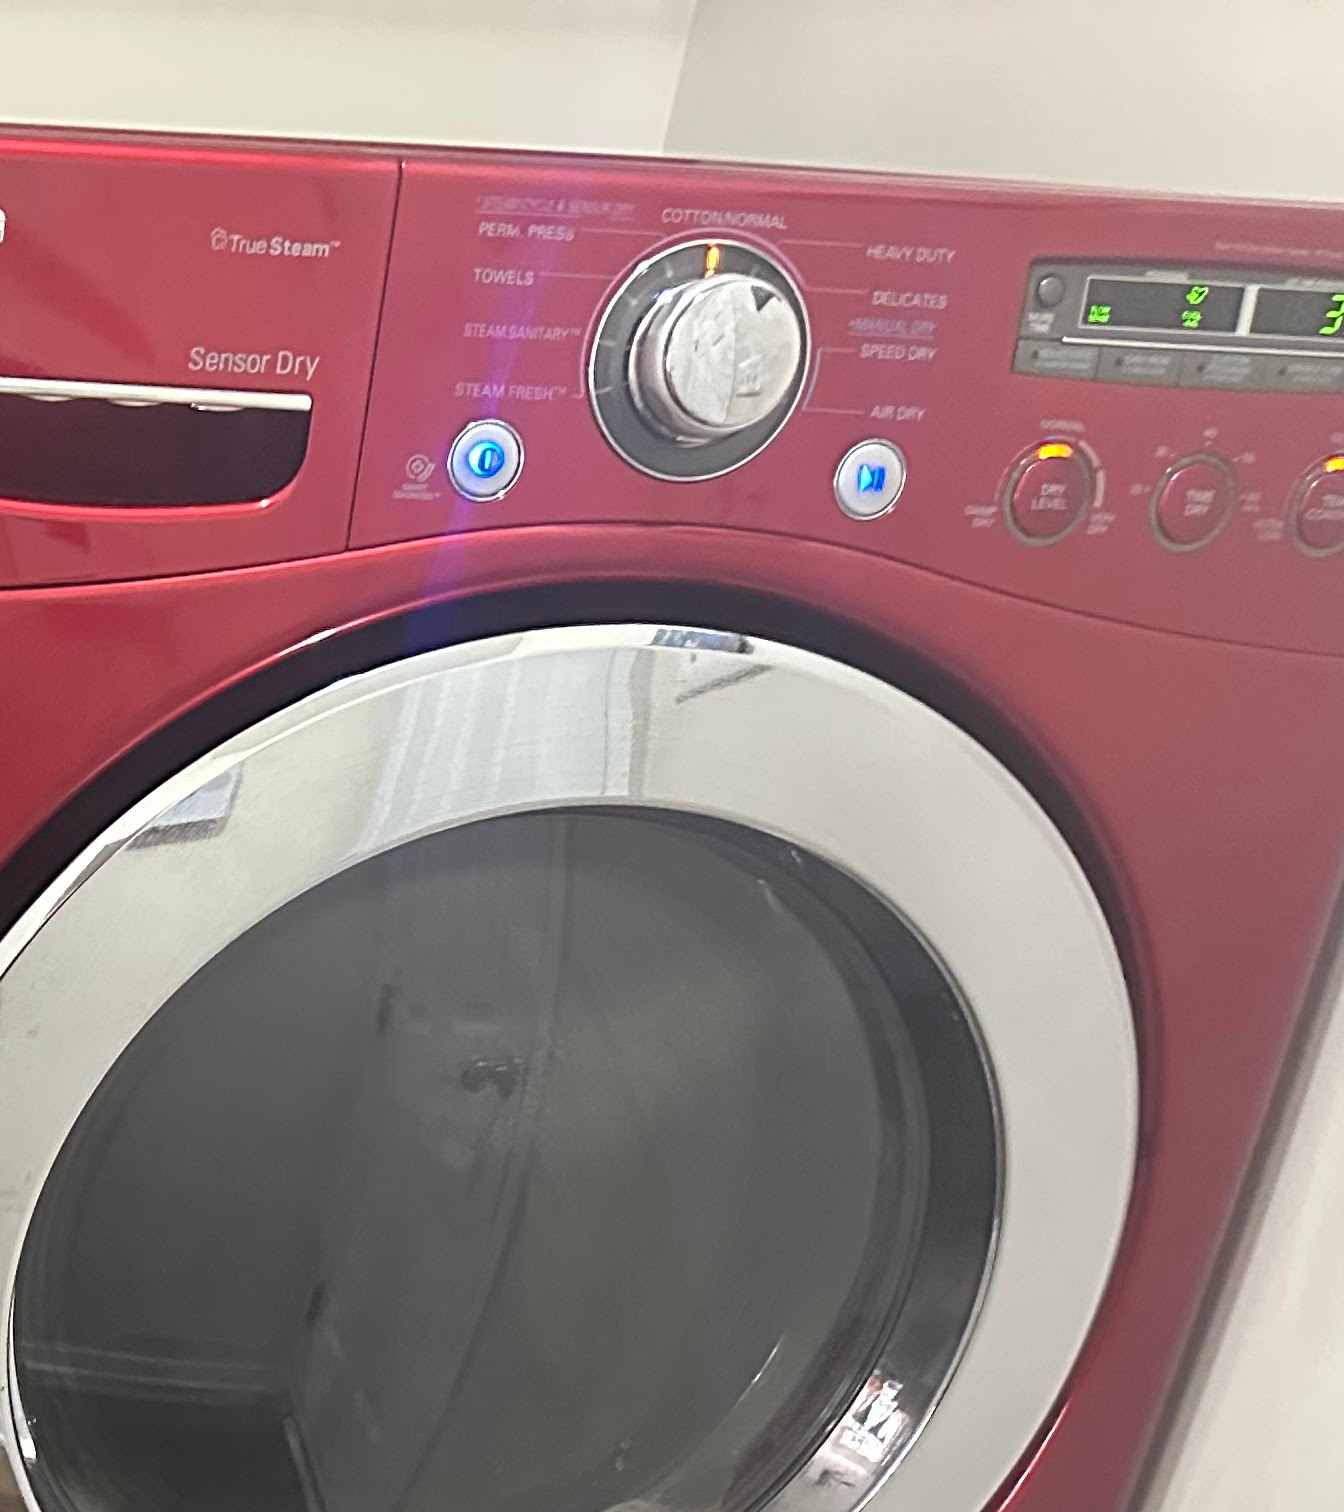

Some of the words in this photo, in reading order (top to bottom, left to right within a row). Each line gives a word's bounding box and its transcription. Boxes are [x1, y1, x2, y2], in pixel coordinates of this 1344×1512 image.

[915, 247, 956, 264] DUTY
[473, 267, 535, 286] TOWELS
[871, 290, 948, 309] DELICATES
[188, 347, 271, 374] Sensor
[275, 349, 320, 381] Dry
[455, 382, 504, 398] STEAM
